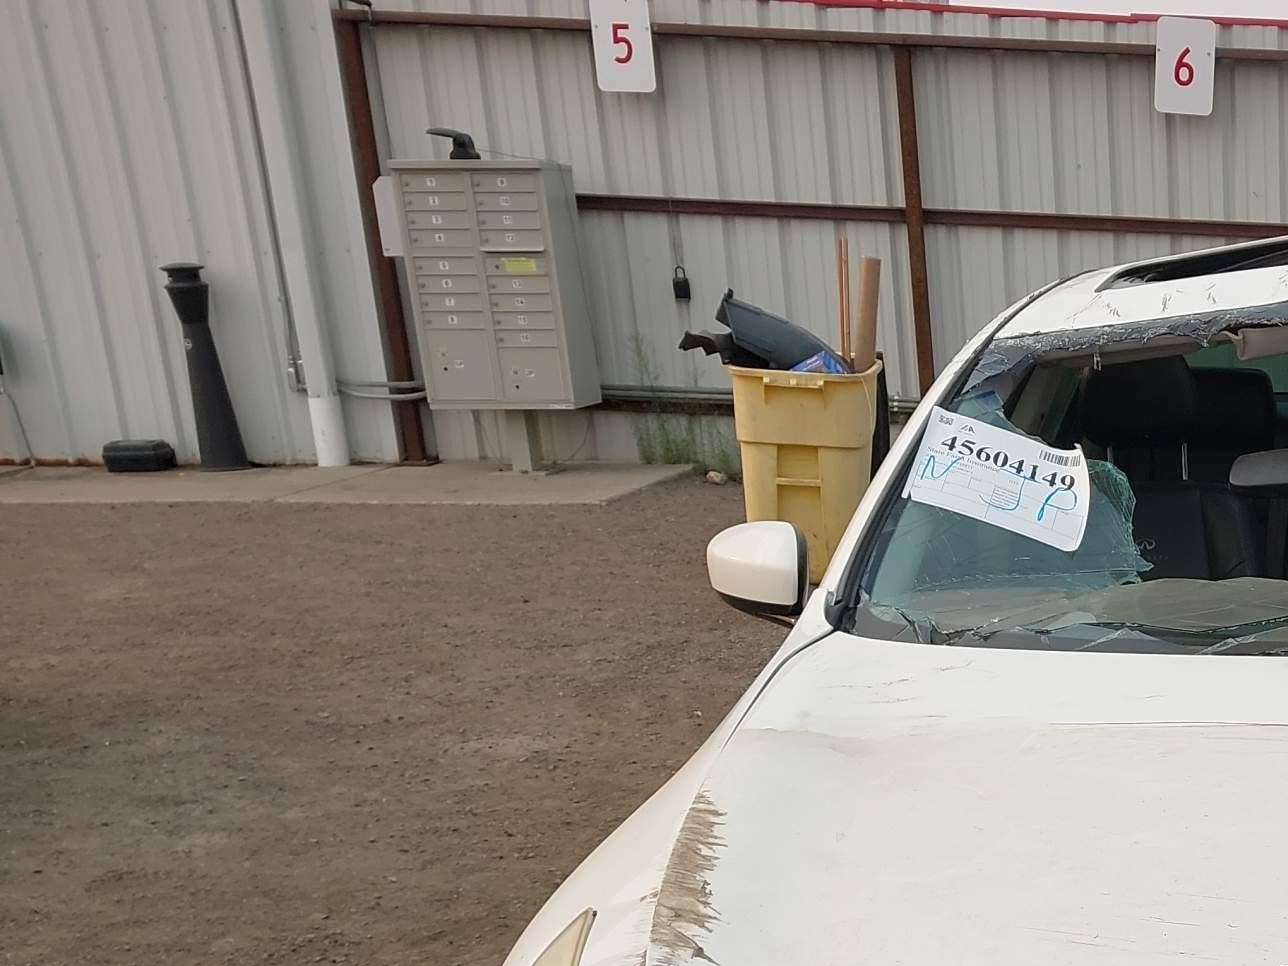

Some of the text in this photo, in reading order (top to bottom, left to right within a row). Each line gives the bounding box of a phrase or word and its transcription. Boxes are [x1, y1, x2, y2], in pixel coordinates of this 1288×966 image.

[612, 23, 633, 64] 5
[1173, 47, 1195, 87] 6
[927, 446, 945, 456] State
[966, 456, 1001, 473] Insurance
[941, 435, 1076, 492] 45604149
